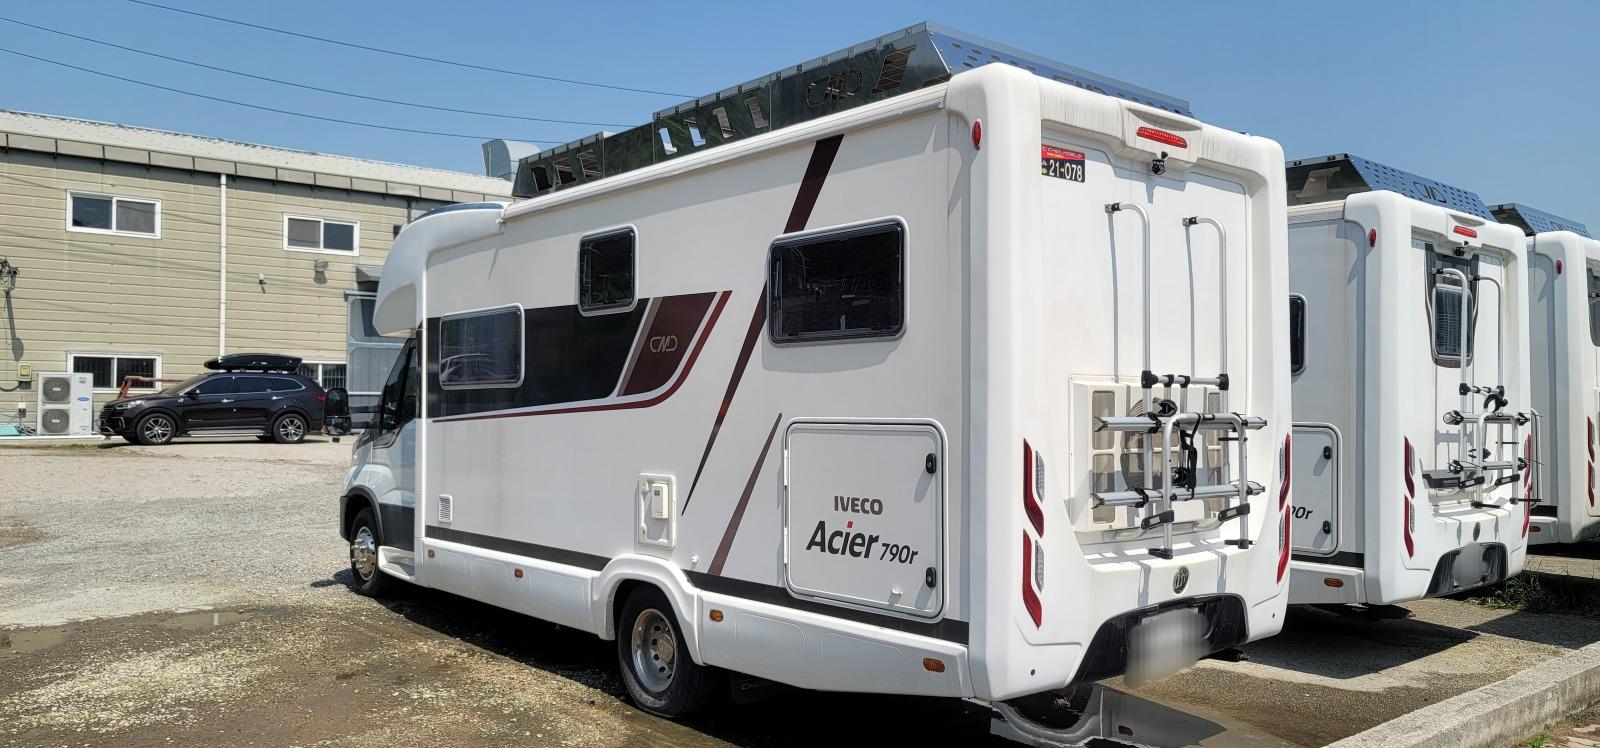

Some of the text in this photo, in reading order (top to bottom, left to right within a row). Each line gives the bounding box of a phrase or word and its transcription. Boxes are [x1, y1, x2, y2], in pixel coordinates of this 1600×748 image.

[1049, 159, 1083, 182] 21-078
[834, 495, 883, 516] IVECO
[806, 520, 919, 565] Acier 790r
